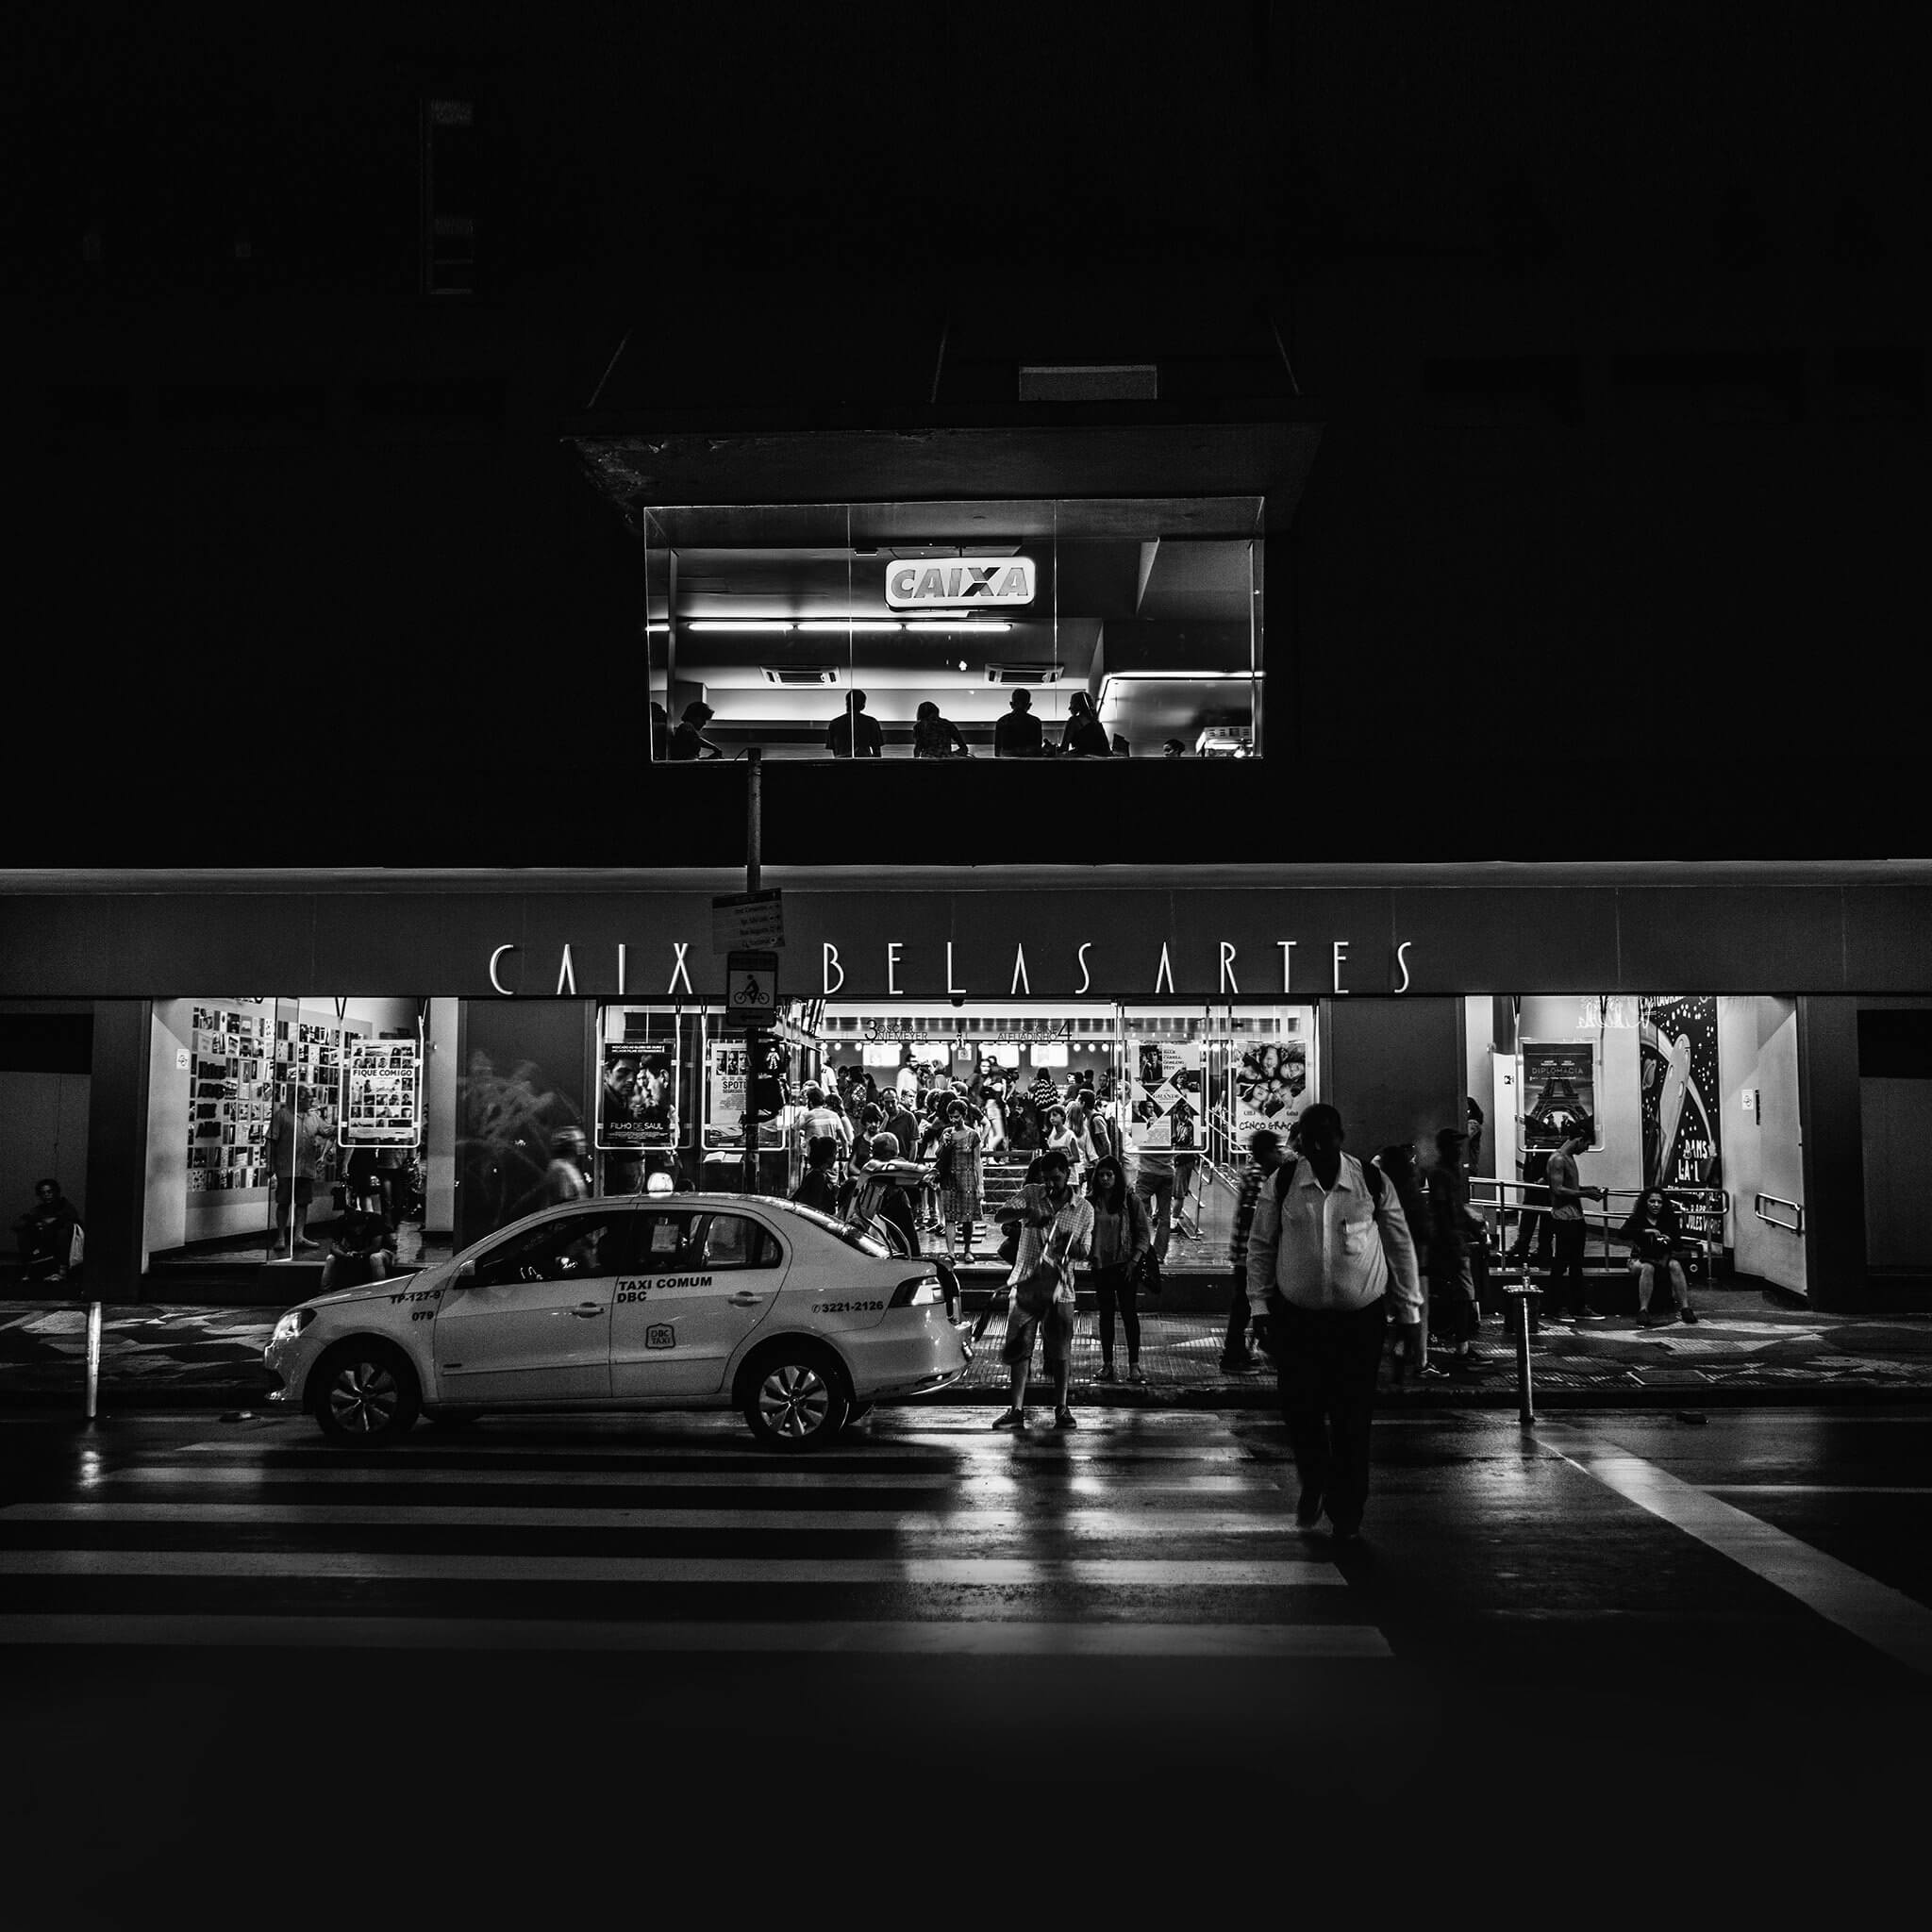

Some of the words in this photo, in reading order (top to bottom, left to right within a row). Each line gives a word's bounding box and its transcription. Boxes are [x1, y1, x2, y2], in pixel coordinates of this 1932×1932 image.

[891, 567, 1028, 599] CAIXA
[489, 942, 693, 995] CAIX
[823, 941, 1092, 995] BELAS
[1154, 941, 1412, 994] ARTES
[864, 1020, 877, 1041] 3
[877, 1024, 914, 1033] OSCAR
[1058, 1020, 1072, 1041] 4
[877, 1032, 928, 1041] NIEMEYER
[353, 1069, 377, 1077] FIQUE
[610, 1122, 632, 1130] FILHO
[643, 1122, 663, 1130] SAUL
[1239, 1121, 1266, 1131] CINCO
[618, 1279, 653, 1291] TAXI
[656, 1276, 712, 1289] COMUM
[617, 1291, 647, 1303] DBC
[822, 1301, 884, 1313] 3221-2126
[411, 1311, 434, 1321] 079
[650, 1329, 670, 1338] DBC
